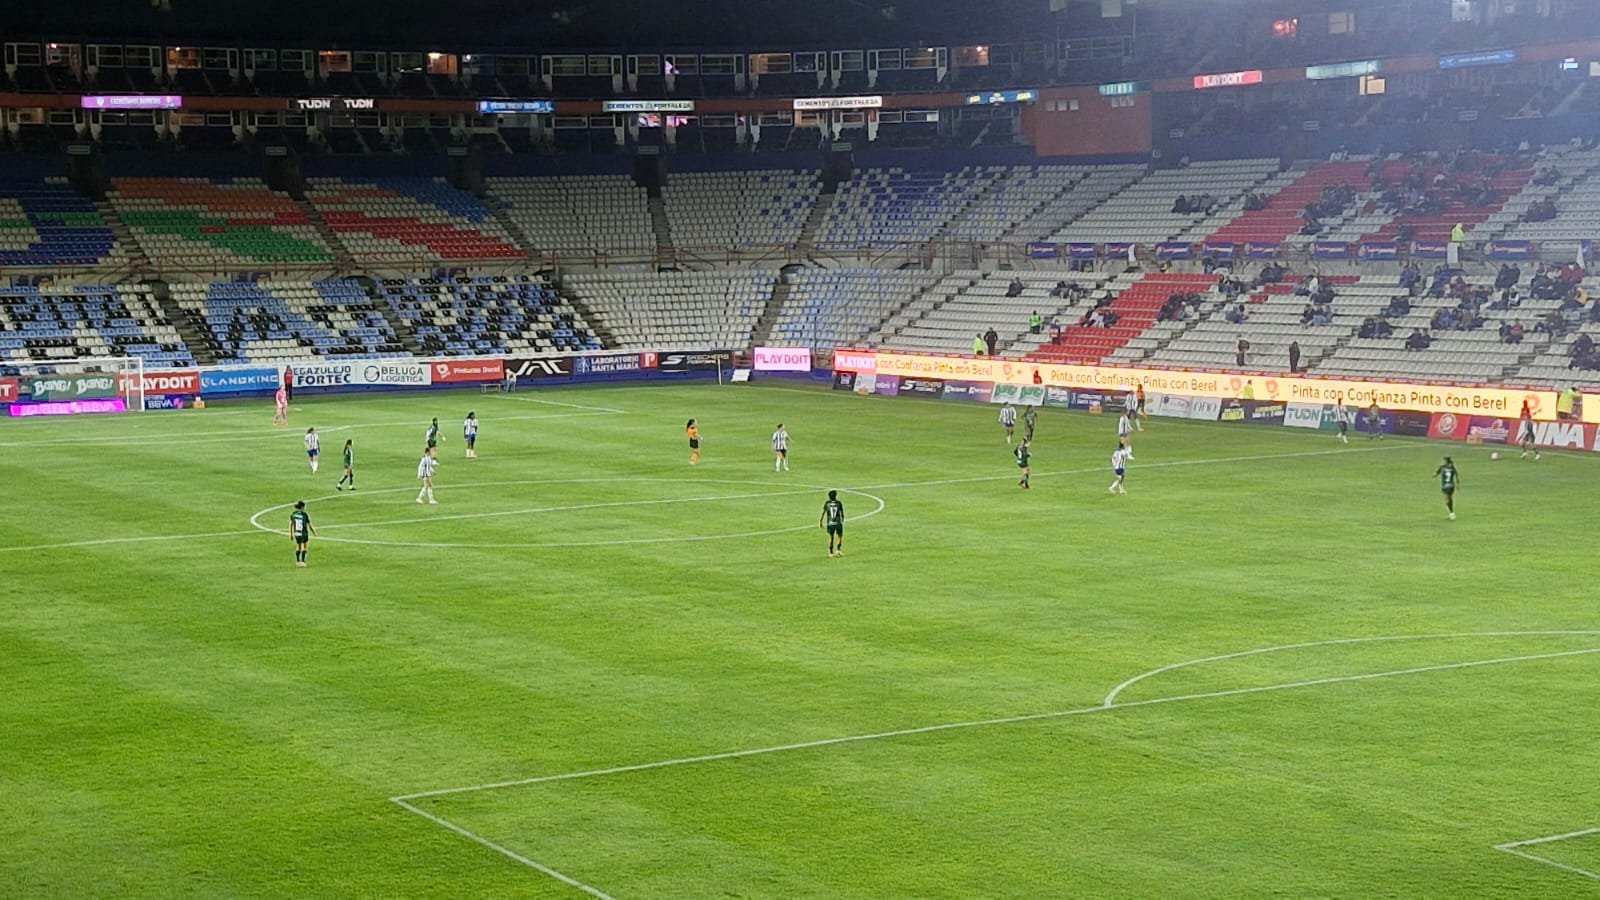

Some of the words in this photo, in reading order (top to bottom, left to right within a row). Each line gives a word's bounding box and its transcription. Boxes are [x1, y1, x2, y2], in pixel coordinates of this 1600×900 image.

[297, 99, 330, 109] TUDN
[344, 98, 373, 109] TUDN
[755, 353, 809, 364] PLAYDOIT
[381, 365, 424, 376] BELUGA
[591, 364, 615, 372] SANTA
[297, 373, 352, 386] FORTEC
[1050, 370, 1073, 382] Pinta
[1073, 373, 1092, 384] con
[1094, 372, 1141, 387] Confianza
[1143, 375, 1169, 389] Pinta
[1169, 379, 1188, 390] con
[1191, 379, 1217, 392] Berel
[1292, 384, 1320, 398] Pinta
[1323, 388, 1344, 400] con
[1347, 387, 1406, 404] Confianza
[1411, 391, 1441, 407] Pinta
[1445, 394, 1469, 409] con
[1473, 395, 1507, 411] Berel
[1288, 407, 1320, 421] TUDN
